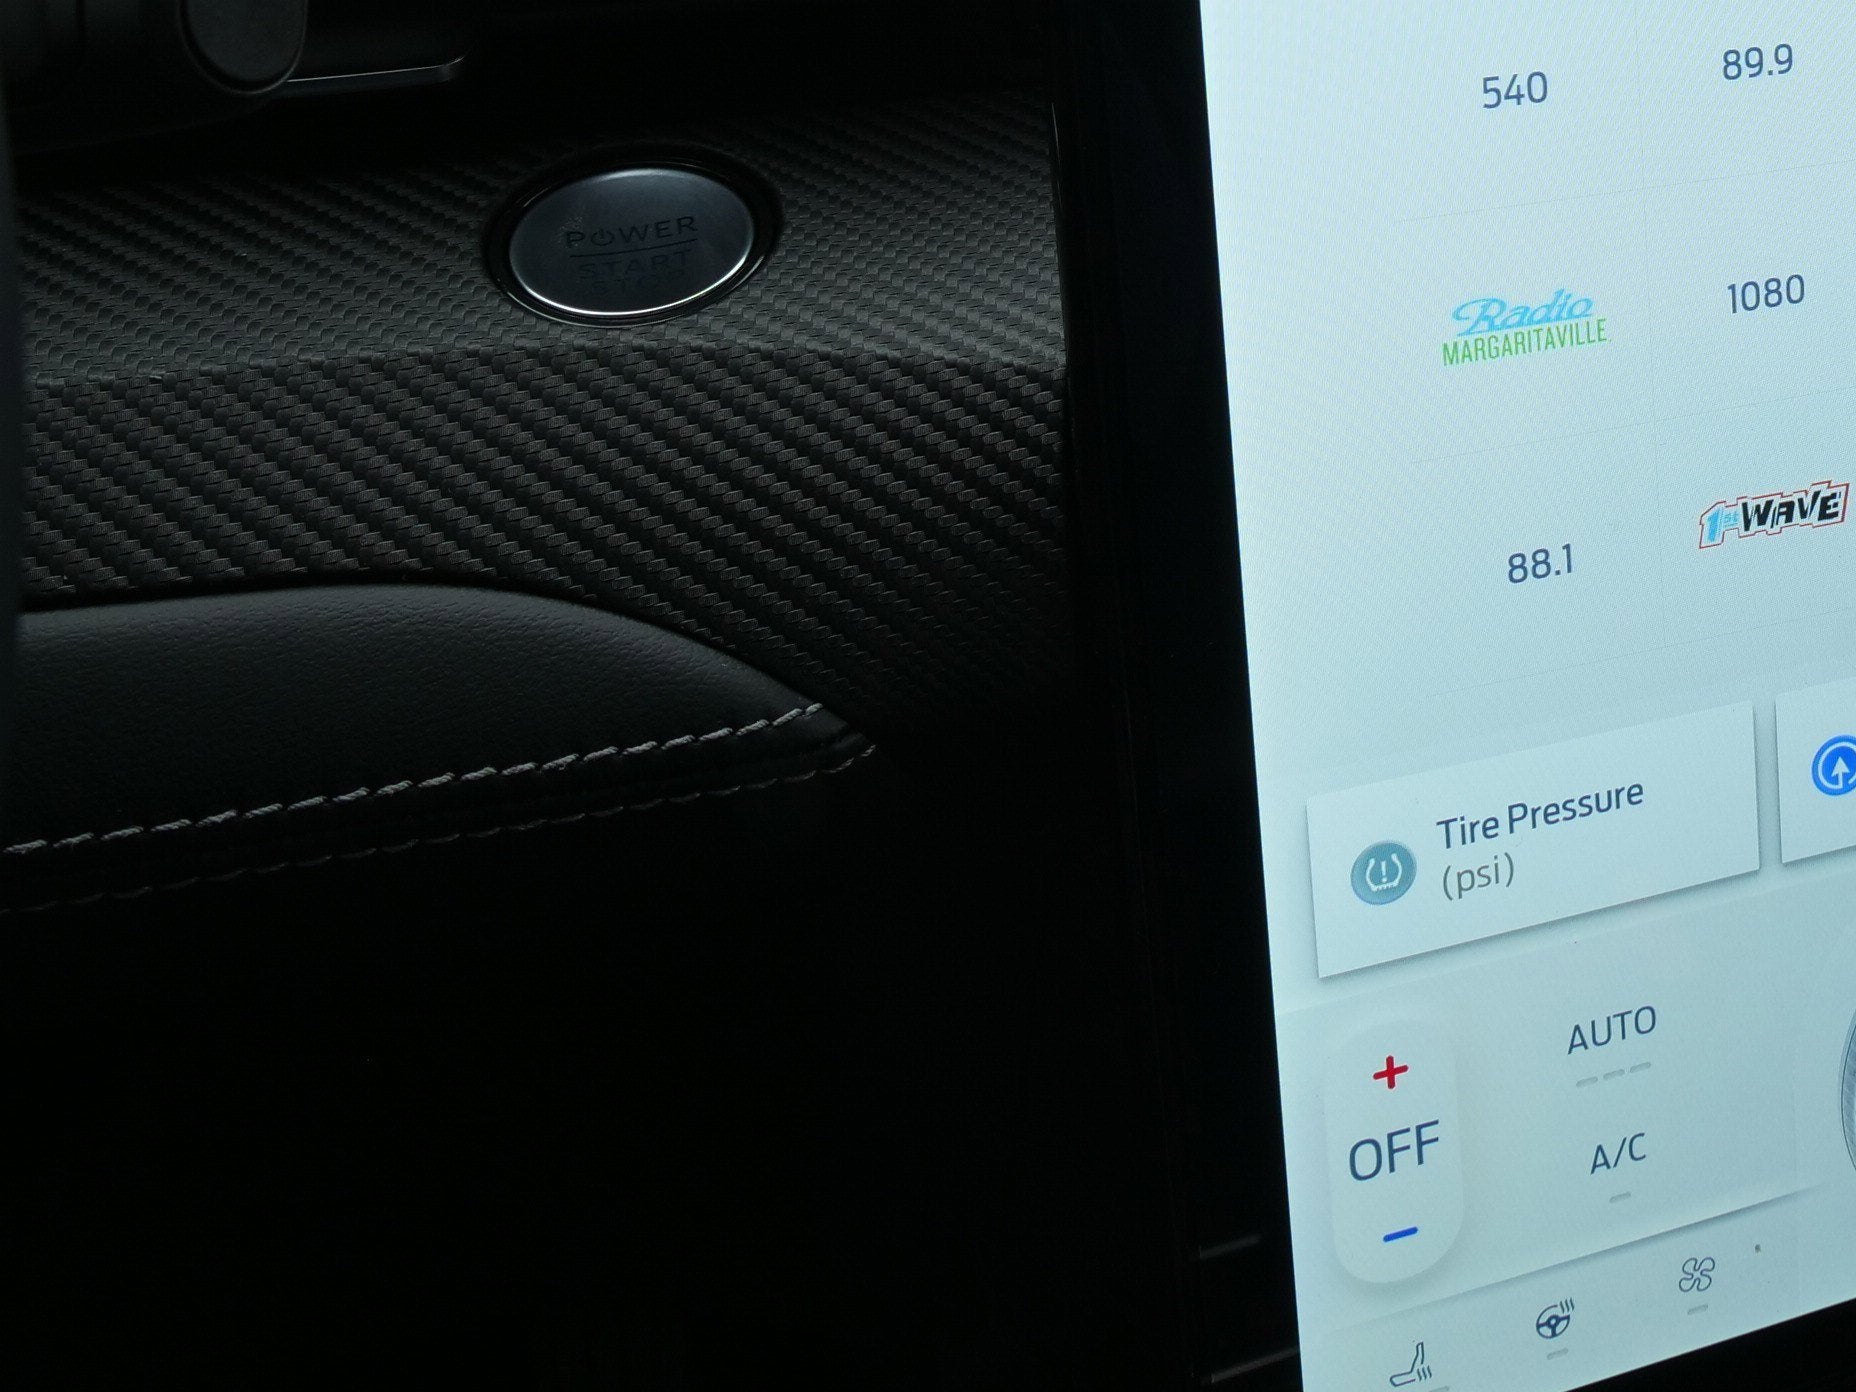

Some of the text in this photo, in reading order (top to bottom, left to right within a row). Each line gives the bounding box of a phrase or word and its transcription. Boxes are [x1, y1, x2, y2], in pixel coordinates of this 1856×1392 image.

[1723, 43, 1794, 81] 89.9
[1483, 71, 1548, 109] 540
[565, 216, 699, 249] POWER
[1452, 288, 1593, 338] Radio
[1727, 274, 1805, 314] 1080
[1443, 318, 1607, 367] MARGARITAVILLE
[1740, 490, 1841, 533] WAVE
[1508, 544, 1573, 584] 88.1
[1436, 782, 1644, 850] Tire Pressure
[1441, 851, 1515, 902] (psi)
[1566, 1004, 1657, 1056] AUTO
[1349, 1119, 1440, 1182] OFF
[1590, 1132, 1647, 1175] A/C
